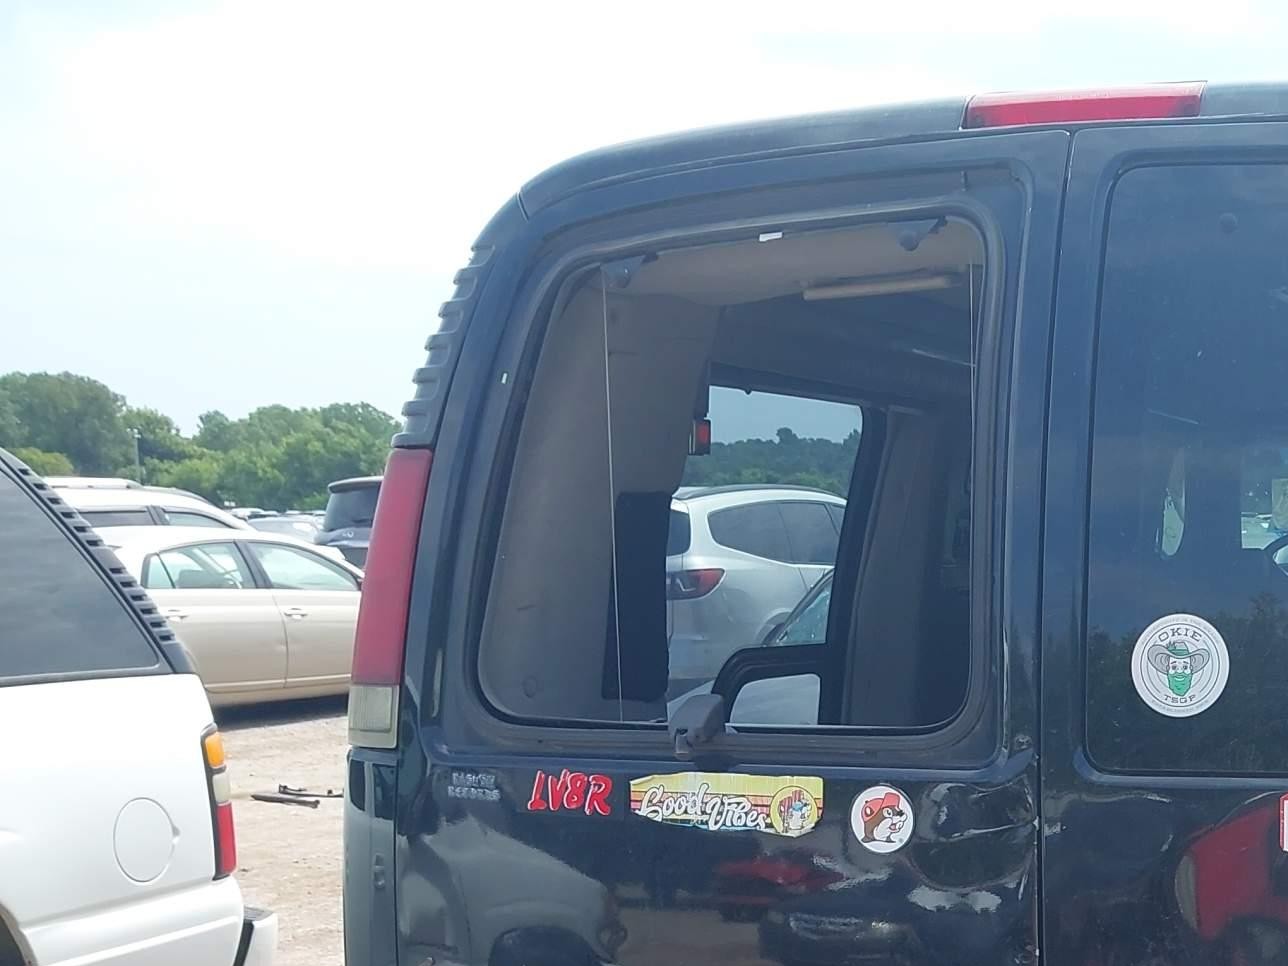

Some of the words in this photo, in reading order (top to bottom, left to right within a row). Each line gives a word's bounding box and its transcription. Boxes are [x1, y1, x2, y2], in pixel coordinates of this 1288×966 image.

[1158, 628, 1202, 642] OKIE
[527, 769, 612, 816] LV8R
[636, 783, 709, 822] Good
[706, 795, 769, 831] Vibes
